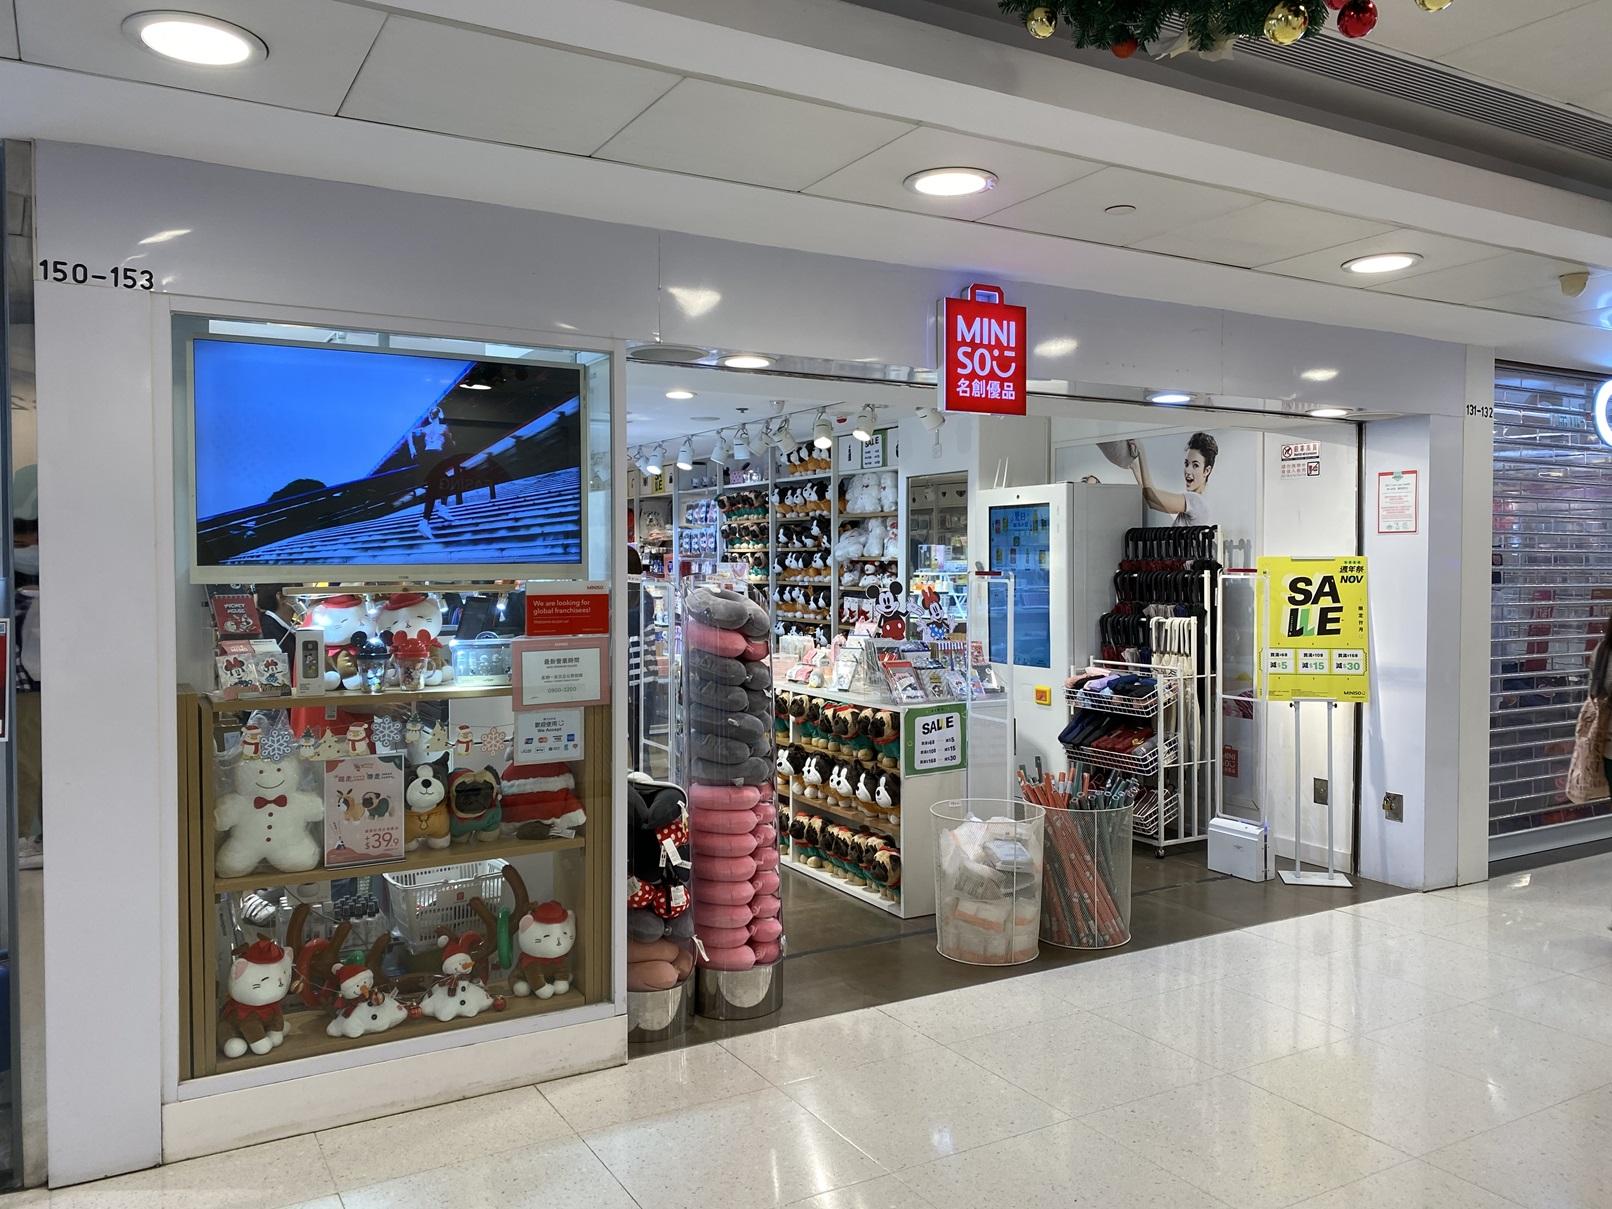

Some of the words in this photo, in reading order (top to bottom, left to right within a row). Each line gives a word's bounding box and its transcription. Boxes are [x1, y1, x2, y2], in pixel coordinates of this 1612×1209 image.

[39, 259, 154, 290] 150-153
[957, 315, 1016, 347] MINI
[957, 378, 1016, 400] 名創優品
[1466, 404, 1493, 418] 131-132
[1340, 565, 1364, 574] 週年祭
[1340, 575, 1364, 584] NOV
[1287, 575, 1341, 606] SA
[557, 599, 580, 607] looking
[533, 607, 554, 616] global
